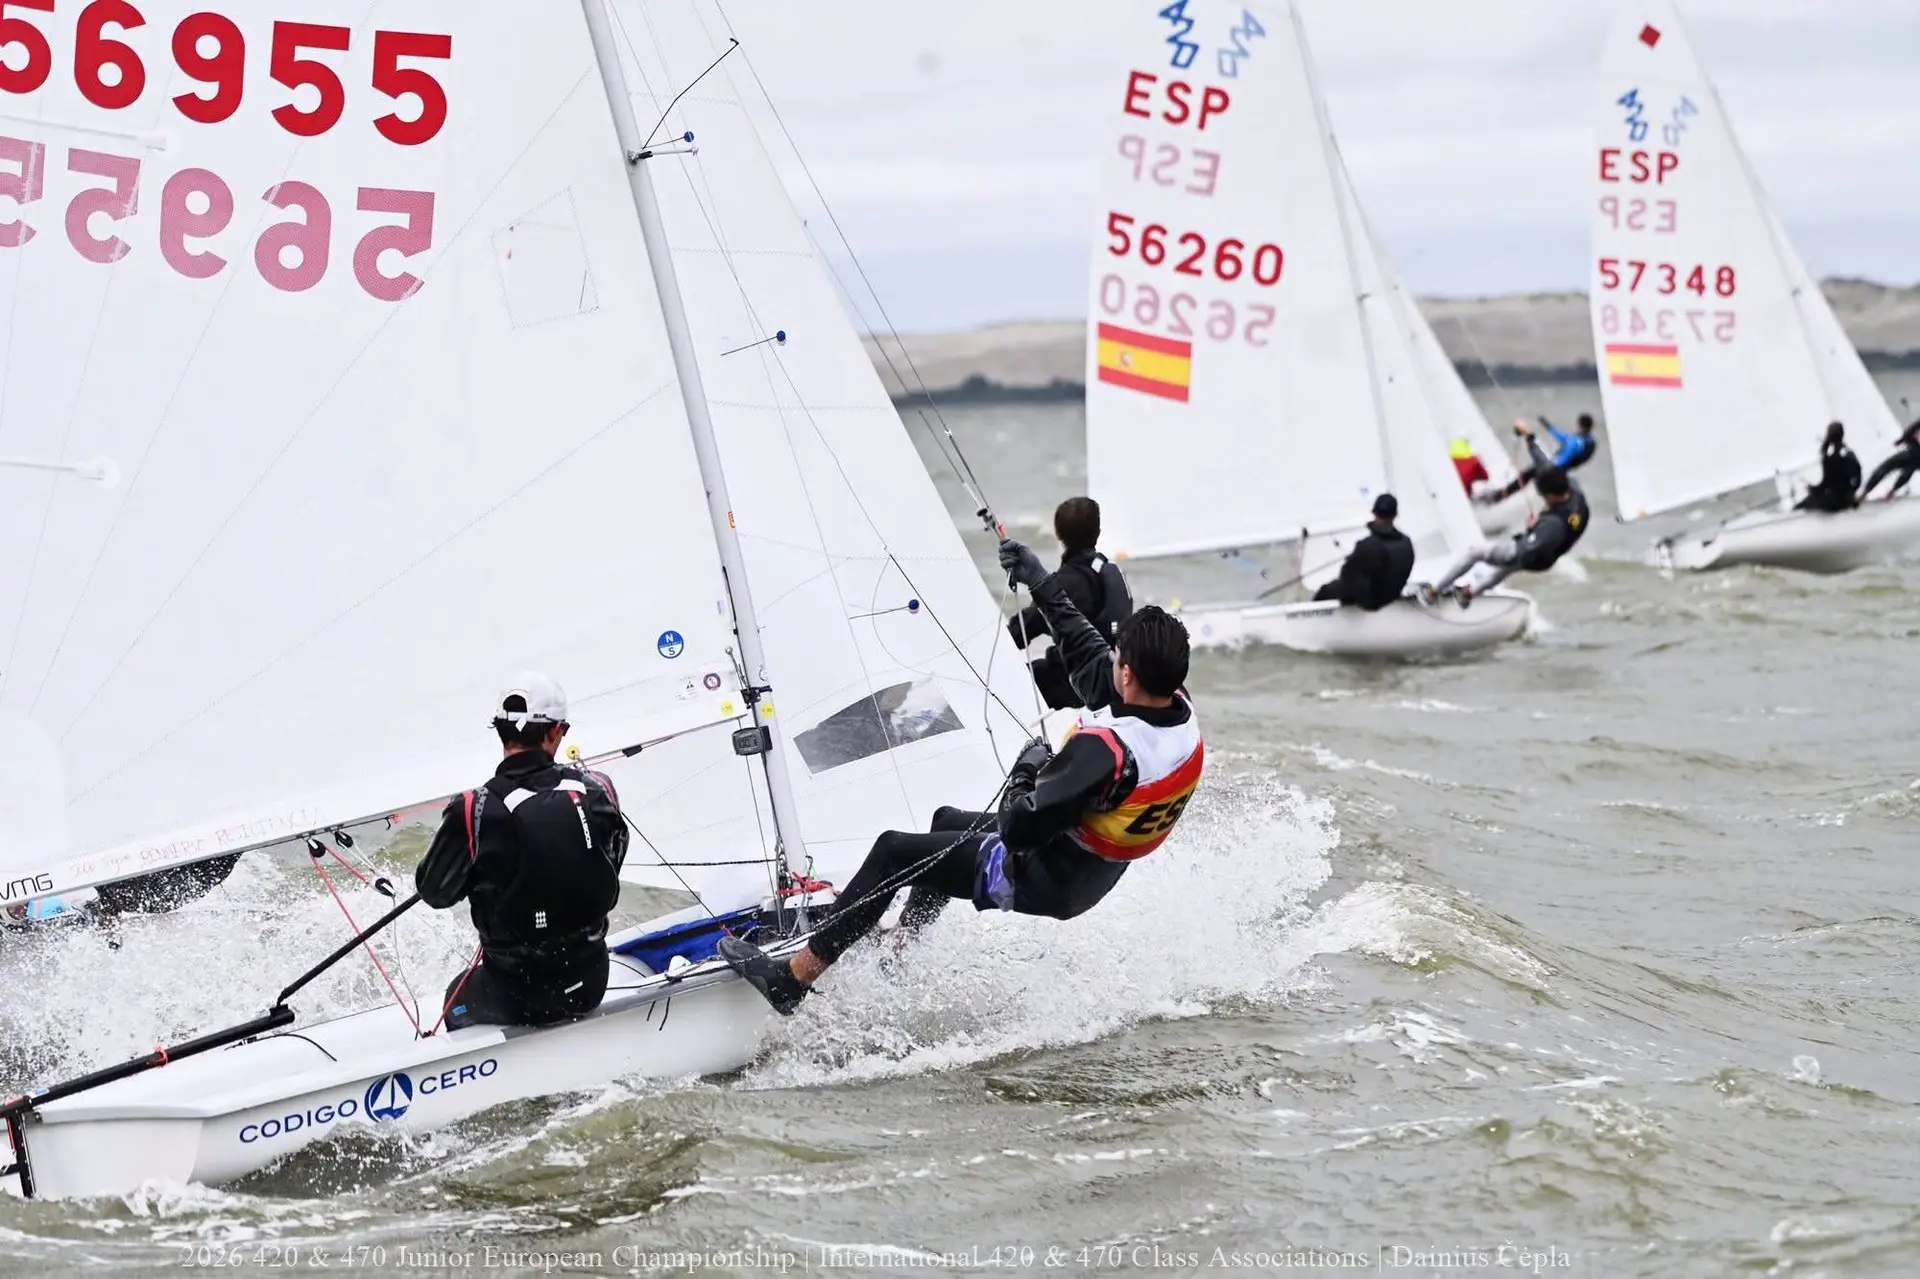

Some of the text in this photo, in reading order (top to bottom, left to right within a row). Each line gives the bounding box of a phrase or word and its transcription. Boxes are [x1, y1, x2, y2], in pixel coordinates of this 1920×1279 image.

[0, 0, 452, 146] 56955
[1123, 70, 1231, 130] ESP
[1599, 148, 1680, 184] ESP
[1106, 211, 1285, 287] 56260
[1598, 258, 1738, 298] 57348
[1124, 788, 1196, 835] ES
[239, 1058, 498, 1143] CODIGO CERO
